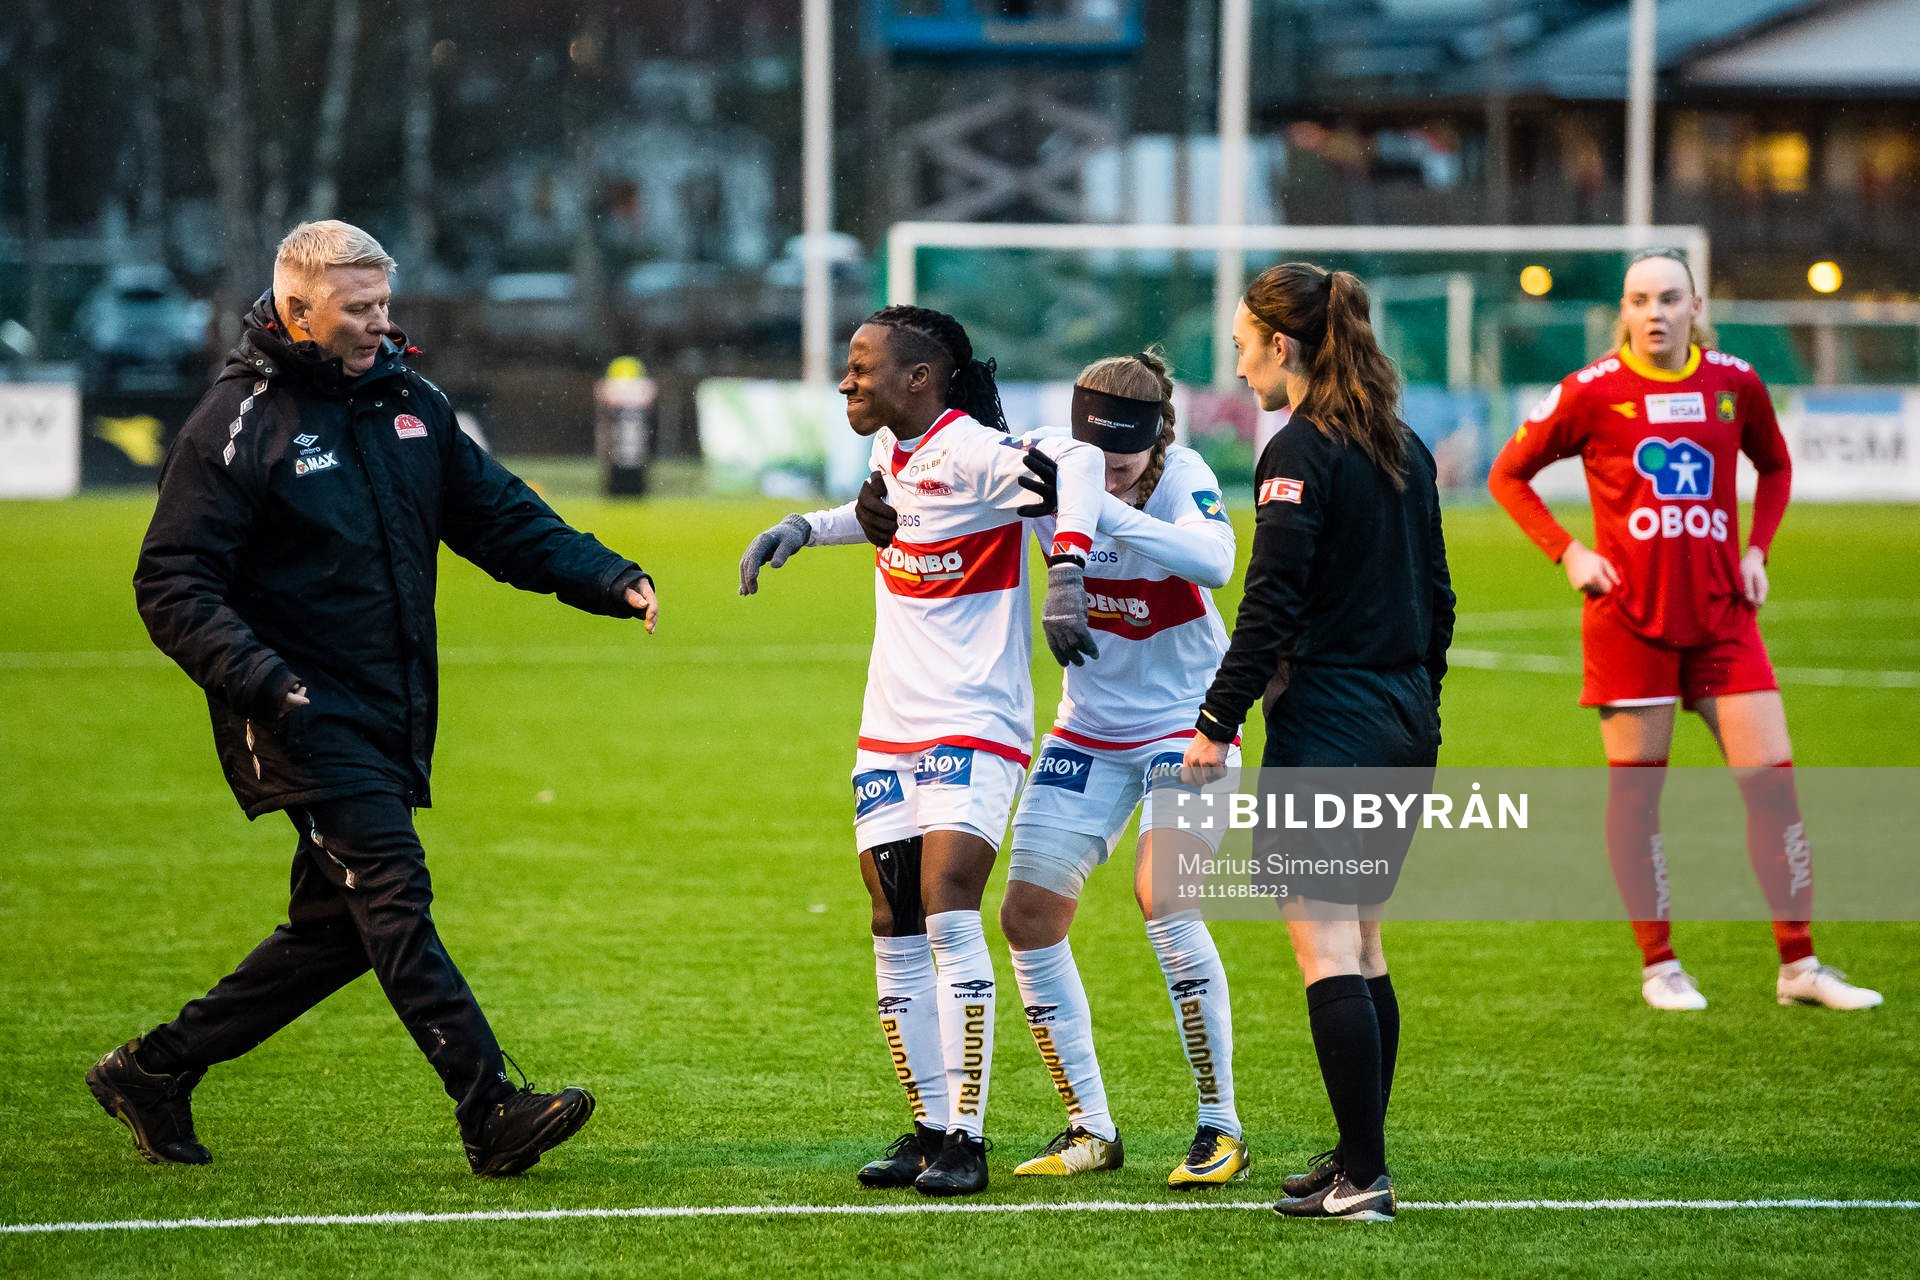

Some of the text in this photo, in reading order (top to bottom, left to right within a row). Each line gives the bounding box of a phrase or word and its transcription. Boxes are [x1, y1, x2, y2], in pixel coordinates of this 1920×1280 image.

[306, 452, 338, 471] MAX
[1628, 505, 1728, 542] OBOS
[1088, 550, 1118, 563] BOS
[914, 755, 966, 773] ERØY
[857, 776, 892, 801] RØY
[880, 851, 890, 861] KT
[954, 990, 992, 999] umbro
[957, 1004, 985, 1117] BUNNPRIS
[1180, 1000, 1220, 1105] BUNNPRIS
